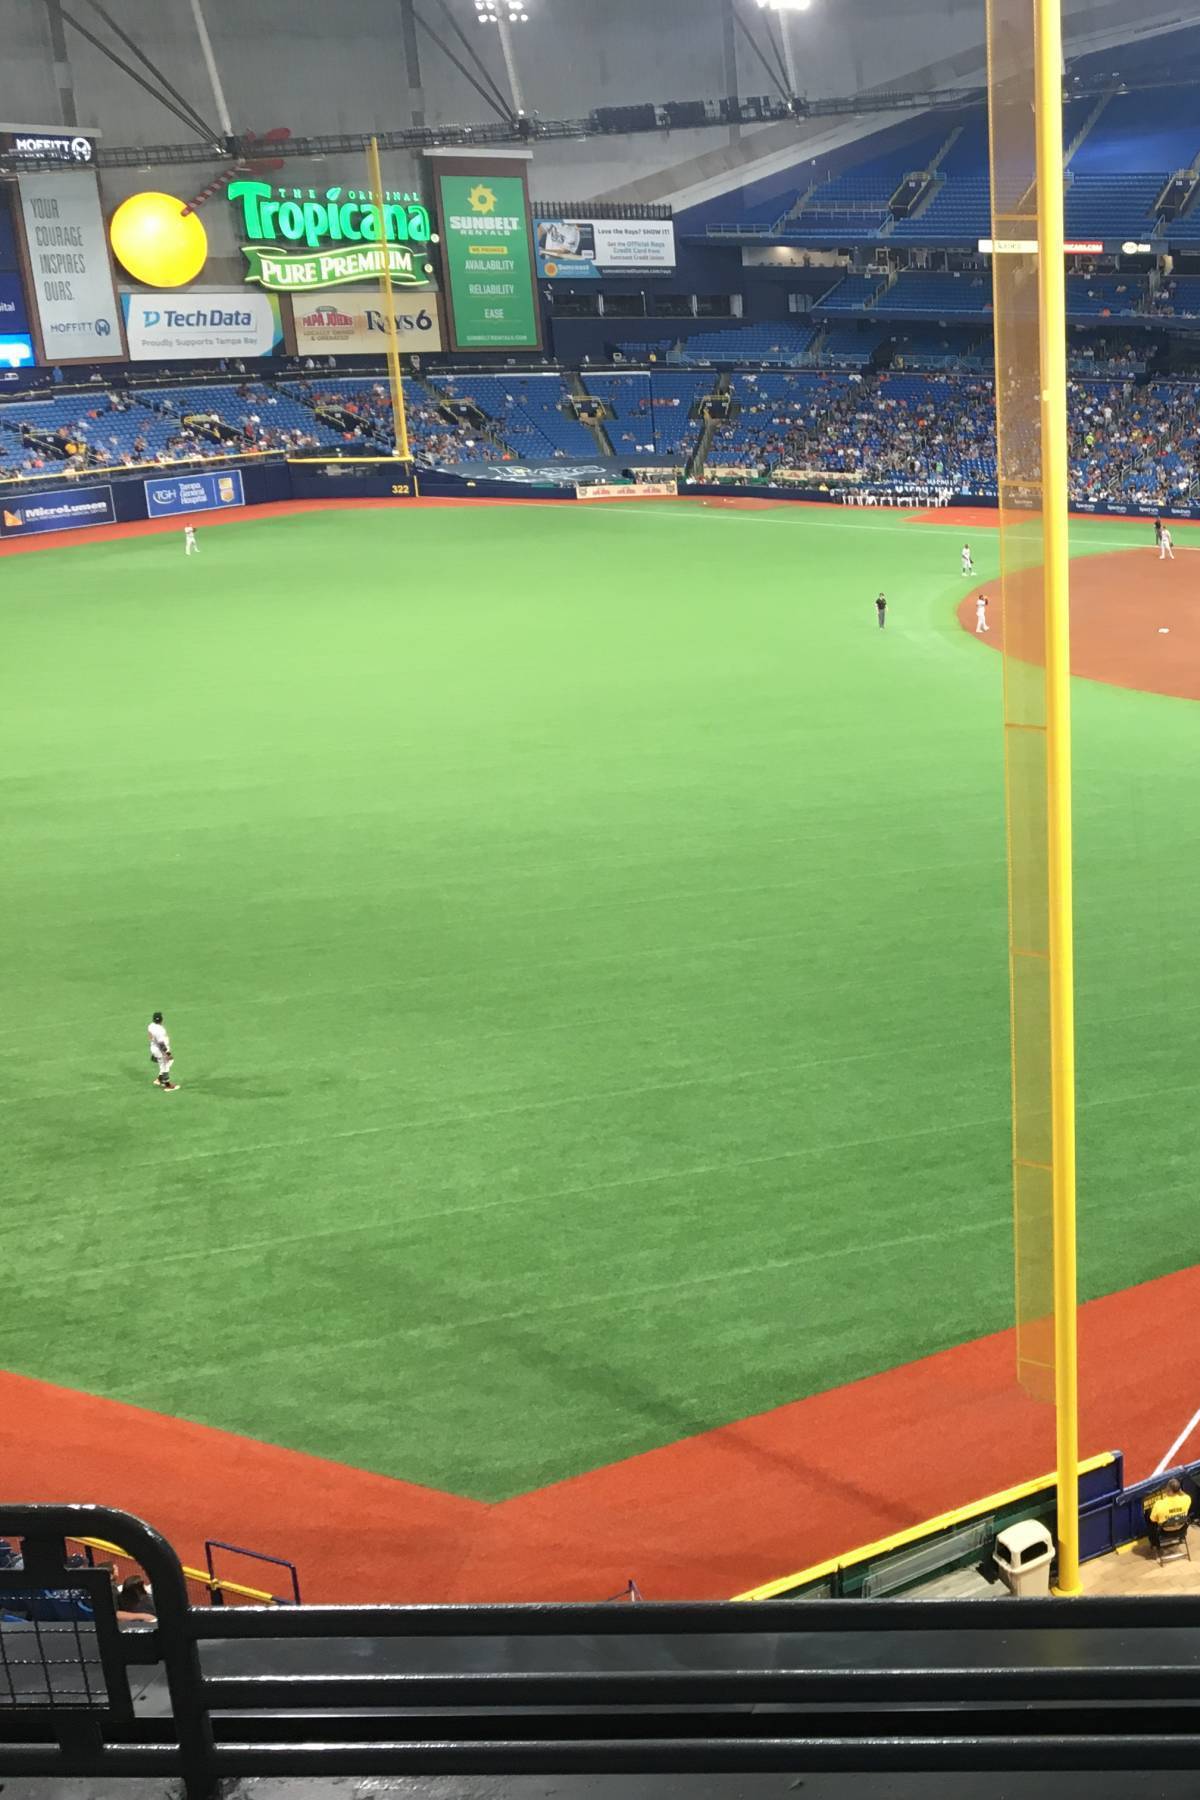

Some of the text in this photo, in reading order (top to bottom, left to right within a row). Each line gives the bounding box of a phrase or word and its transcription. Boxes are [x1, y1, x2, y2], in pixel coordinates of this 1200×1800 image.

[16, 138, 69, 152] MOFFITT
[278, 188, 420, 202] THE ORIINAL
[30, 198, 60, 219] YOUR
[227, 181, 431, 247] Tropicana
[449, 216, 520, 230] SUNBELT
[35, 226, 84, 247] COURAGE
[40, 253, 86, 275] INSPIRES
[260, 258, 318, 284] PURE
[465, 260, 514, 270] AVAILABILITY
[44, 281, 75, 302] OURS.
[468, 284, 514, 294] RELIABILITY
[484, 308, 504, 318] EASE
[51, 321, 93, 334] MOFFITT
[141, 337, 258, 348] Proudly Supports Tampa Bay
[156, 488, 177, 500] TGH
[391, 485, 410, 494] 322
[25, 501, 107, 518] MicroLumen
